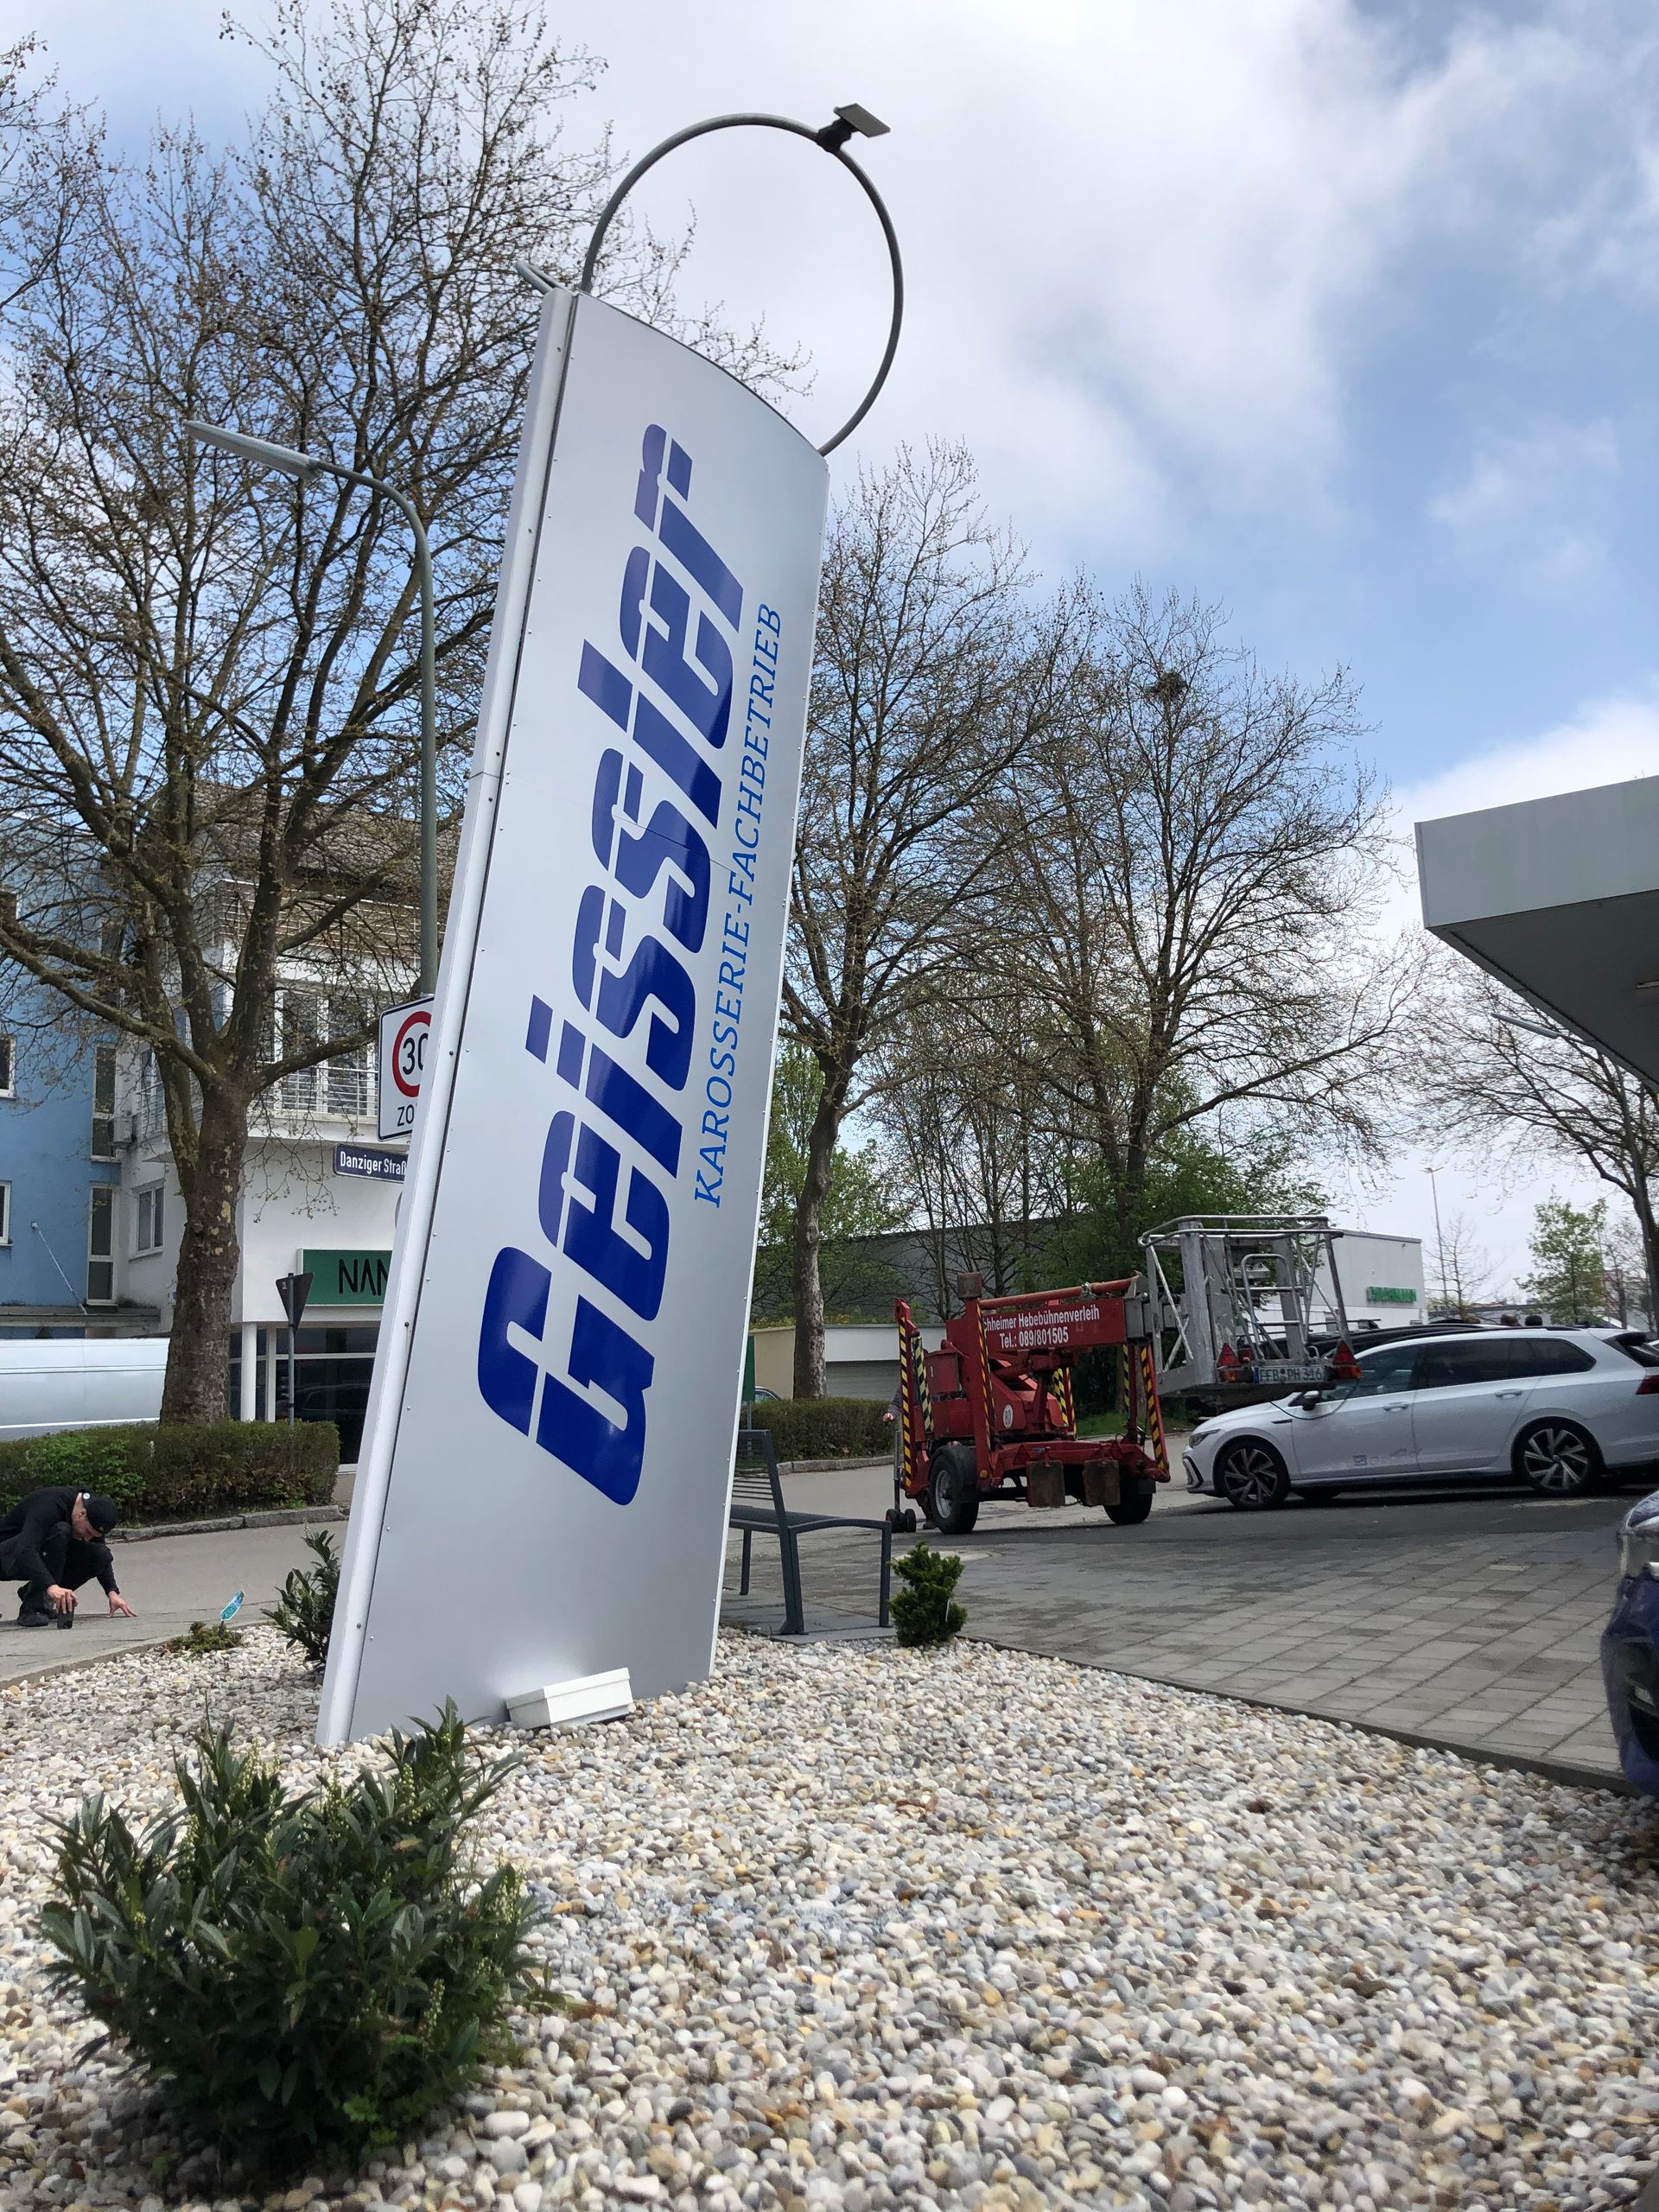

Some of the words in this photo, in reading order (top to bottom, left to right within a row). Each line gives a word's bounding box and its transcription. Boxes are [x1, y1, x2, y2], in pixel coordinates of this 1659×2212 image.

[694, 602, 781, 1209] KAROSSERIE-FACHBETRIEB
[478, 423, 743, 1505] Geissler
[397, 1103, 416, 1127] ZO
[340, 1151, 382, 1175] Danziger
[384, 1158, 407, 1175] Straß
[984, 1315, 1017, 1332] hheimer
[1019, 1304, 1100, 1328] Hebebühnenverleih
[1000, 1332, 1017, 1349] Tel.:
[1019, 1326, 1069, 1347] 089/801505
[1259, 1369, 1279, 1382] FFB
